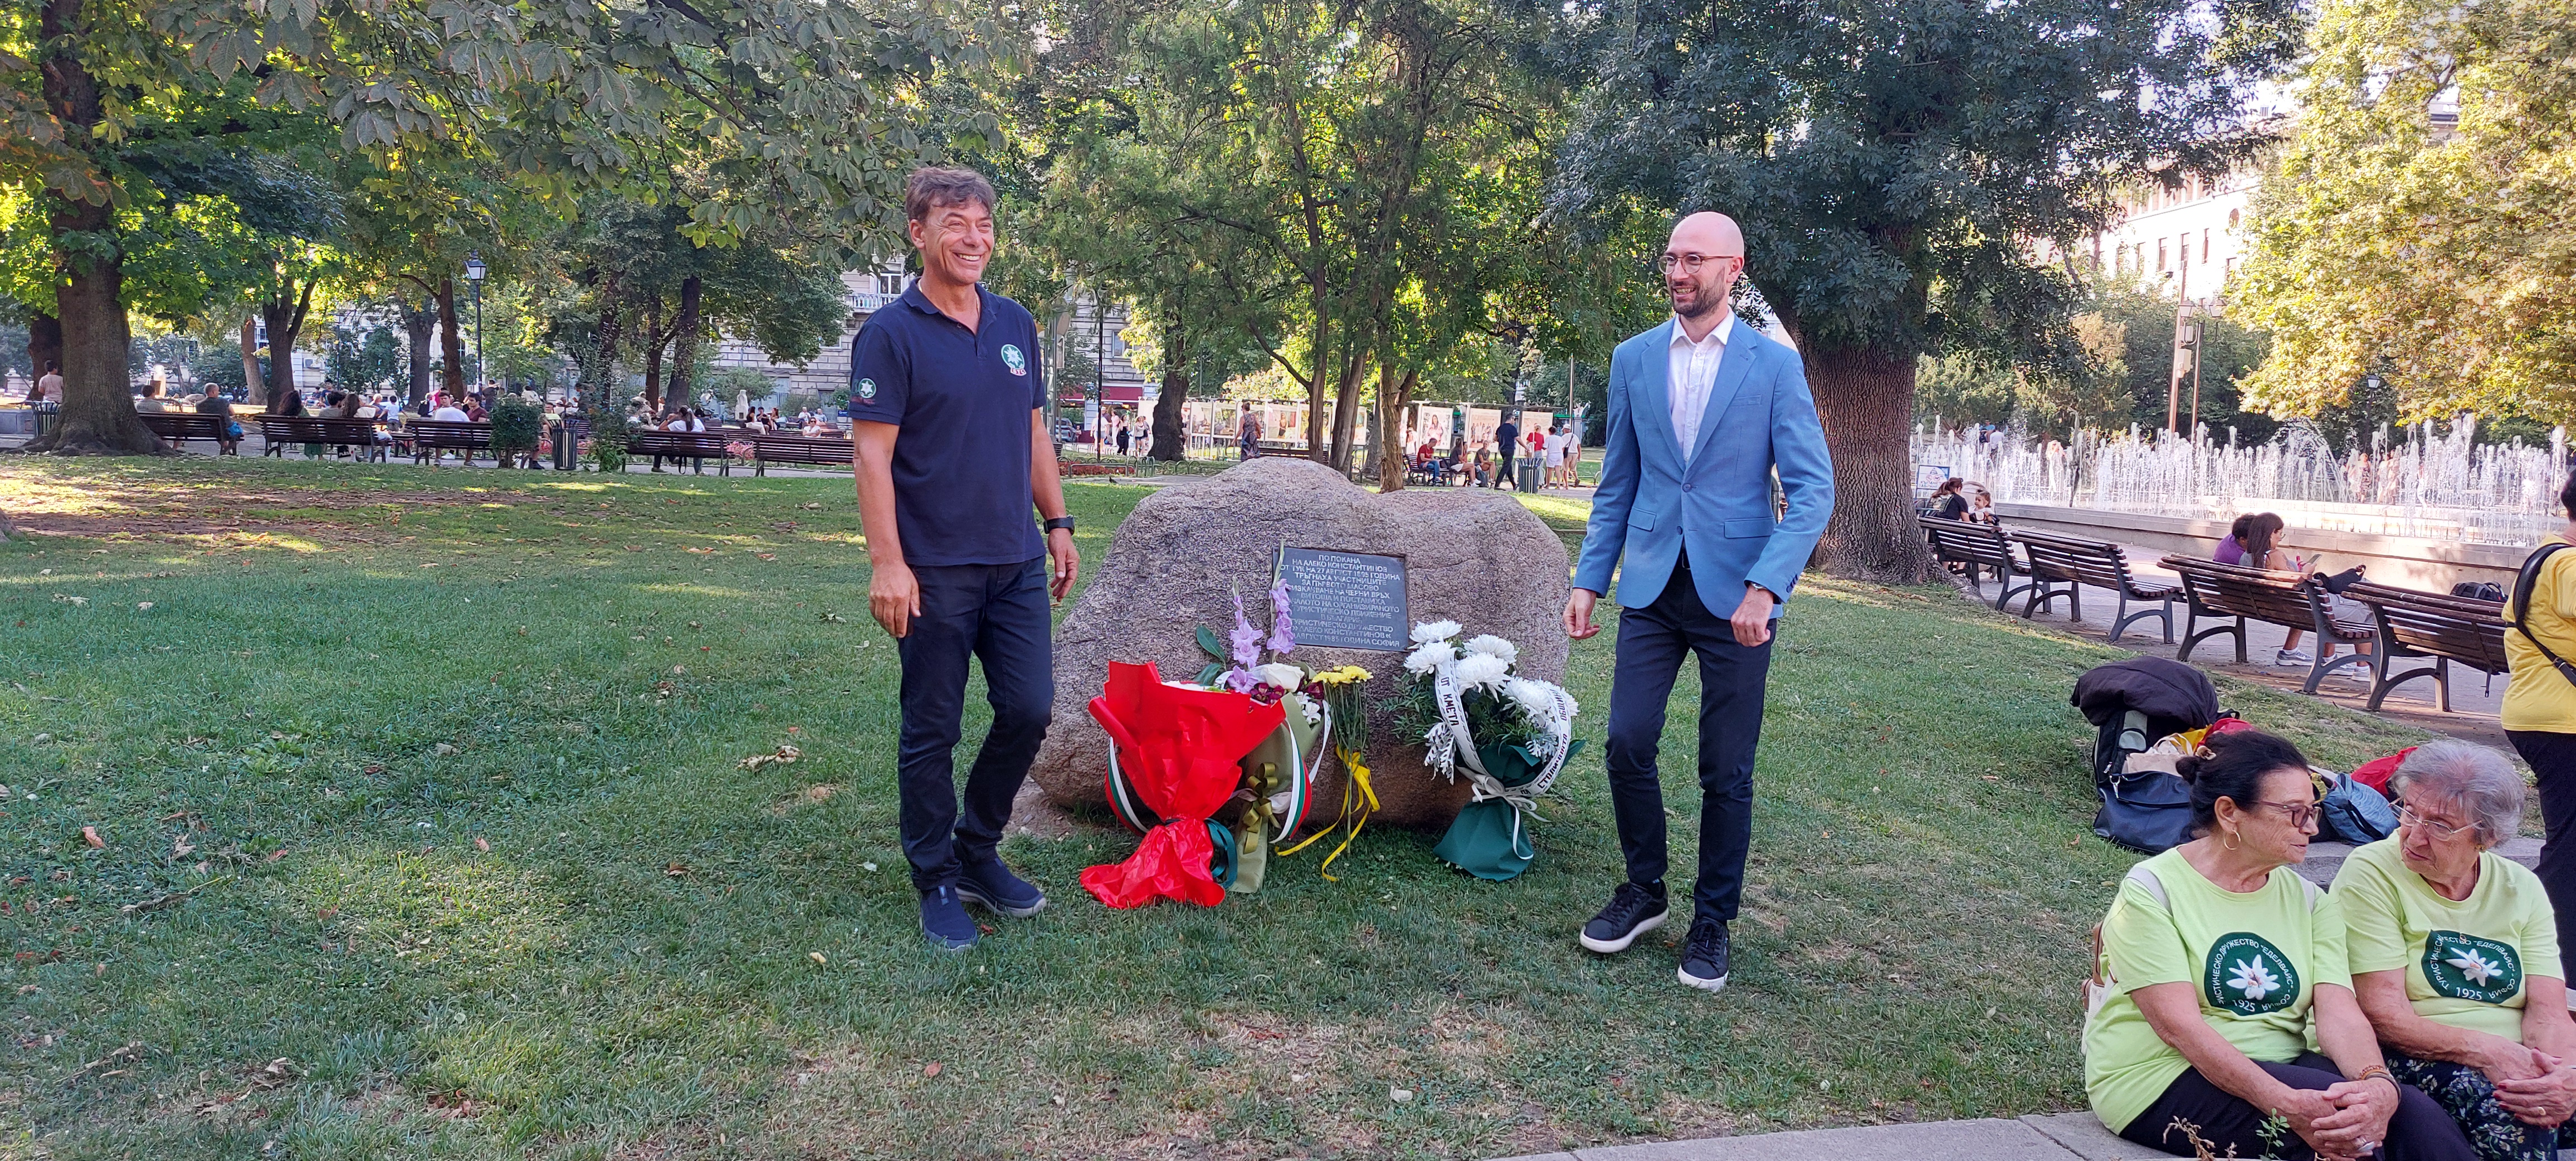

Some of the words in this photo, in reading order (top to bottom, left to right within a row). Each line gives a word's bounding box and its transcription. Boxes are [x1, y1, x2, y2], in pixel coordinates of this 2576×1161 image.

[1331, 555, 1360, 564] ПОКАНА
[1325, 568, 1353, 576] АВГУСТ
[1370, 572, 1400, 580] ГОДИНА
[1328, 562, 1387, 573] КОНСТАНТИНОВ
[1294, 572, 1332, 581] ТРЪГНАХА
[1334, 575, 1387, 585] УЧАСТНИЦИТЕ
[1292, 585, 1334, 594] ИЗКАЧВАНЕ
[1312, 580, 1346, 588] ПЪРВОТО
[1347, 583, 1379, 591] МАСОВО
[1301, 592, 1333, 601] ВИТОША
[1340, 596, 1385, 605] ПОСТАВИХА
[1290, 598, 1320, 606] ЧАЛОТО
[1333, 602, 1399, 613] ОРГАНИЗИРАНОТО
[1291, 618, 1346, 629] ТУРИСТИЧЕСКО
[1348, 623, 1393, 632] ДРУЖЕСТВО
[1296, 632, 1324, 641] АВГУСТ
[1340, 636, 1371, 645] ГОДИНА
[1372, 638, 1400, 647] СОФИЯ
[1443, 693, 1460, 726] КМЕТА
[2211, 953, 2226, 1004] ИСТИЧЕСКО
[2221, 938, 2259, 957] ДРУЖЕСТВО
[2430, 934, 2449, 990] ТУРИСТИЧЕСК
[2487, 978, 2515, 999] СОФИЯ
[2456, 987, 2482, 1001] 1925
[2232, 999, 2256, 1012] 1925
